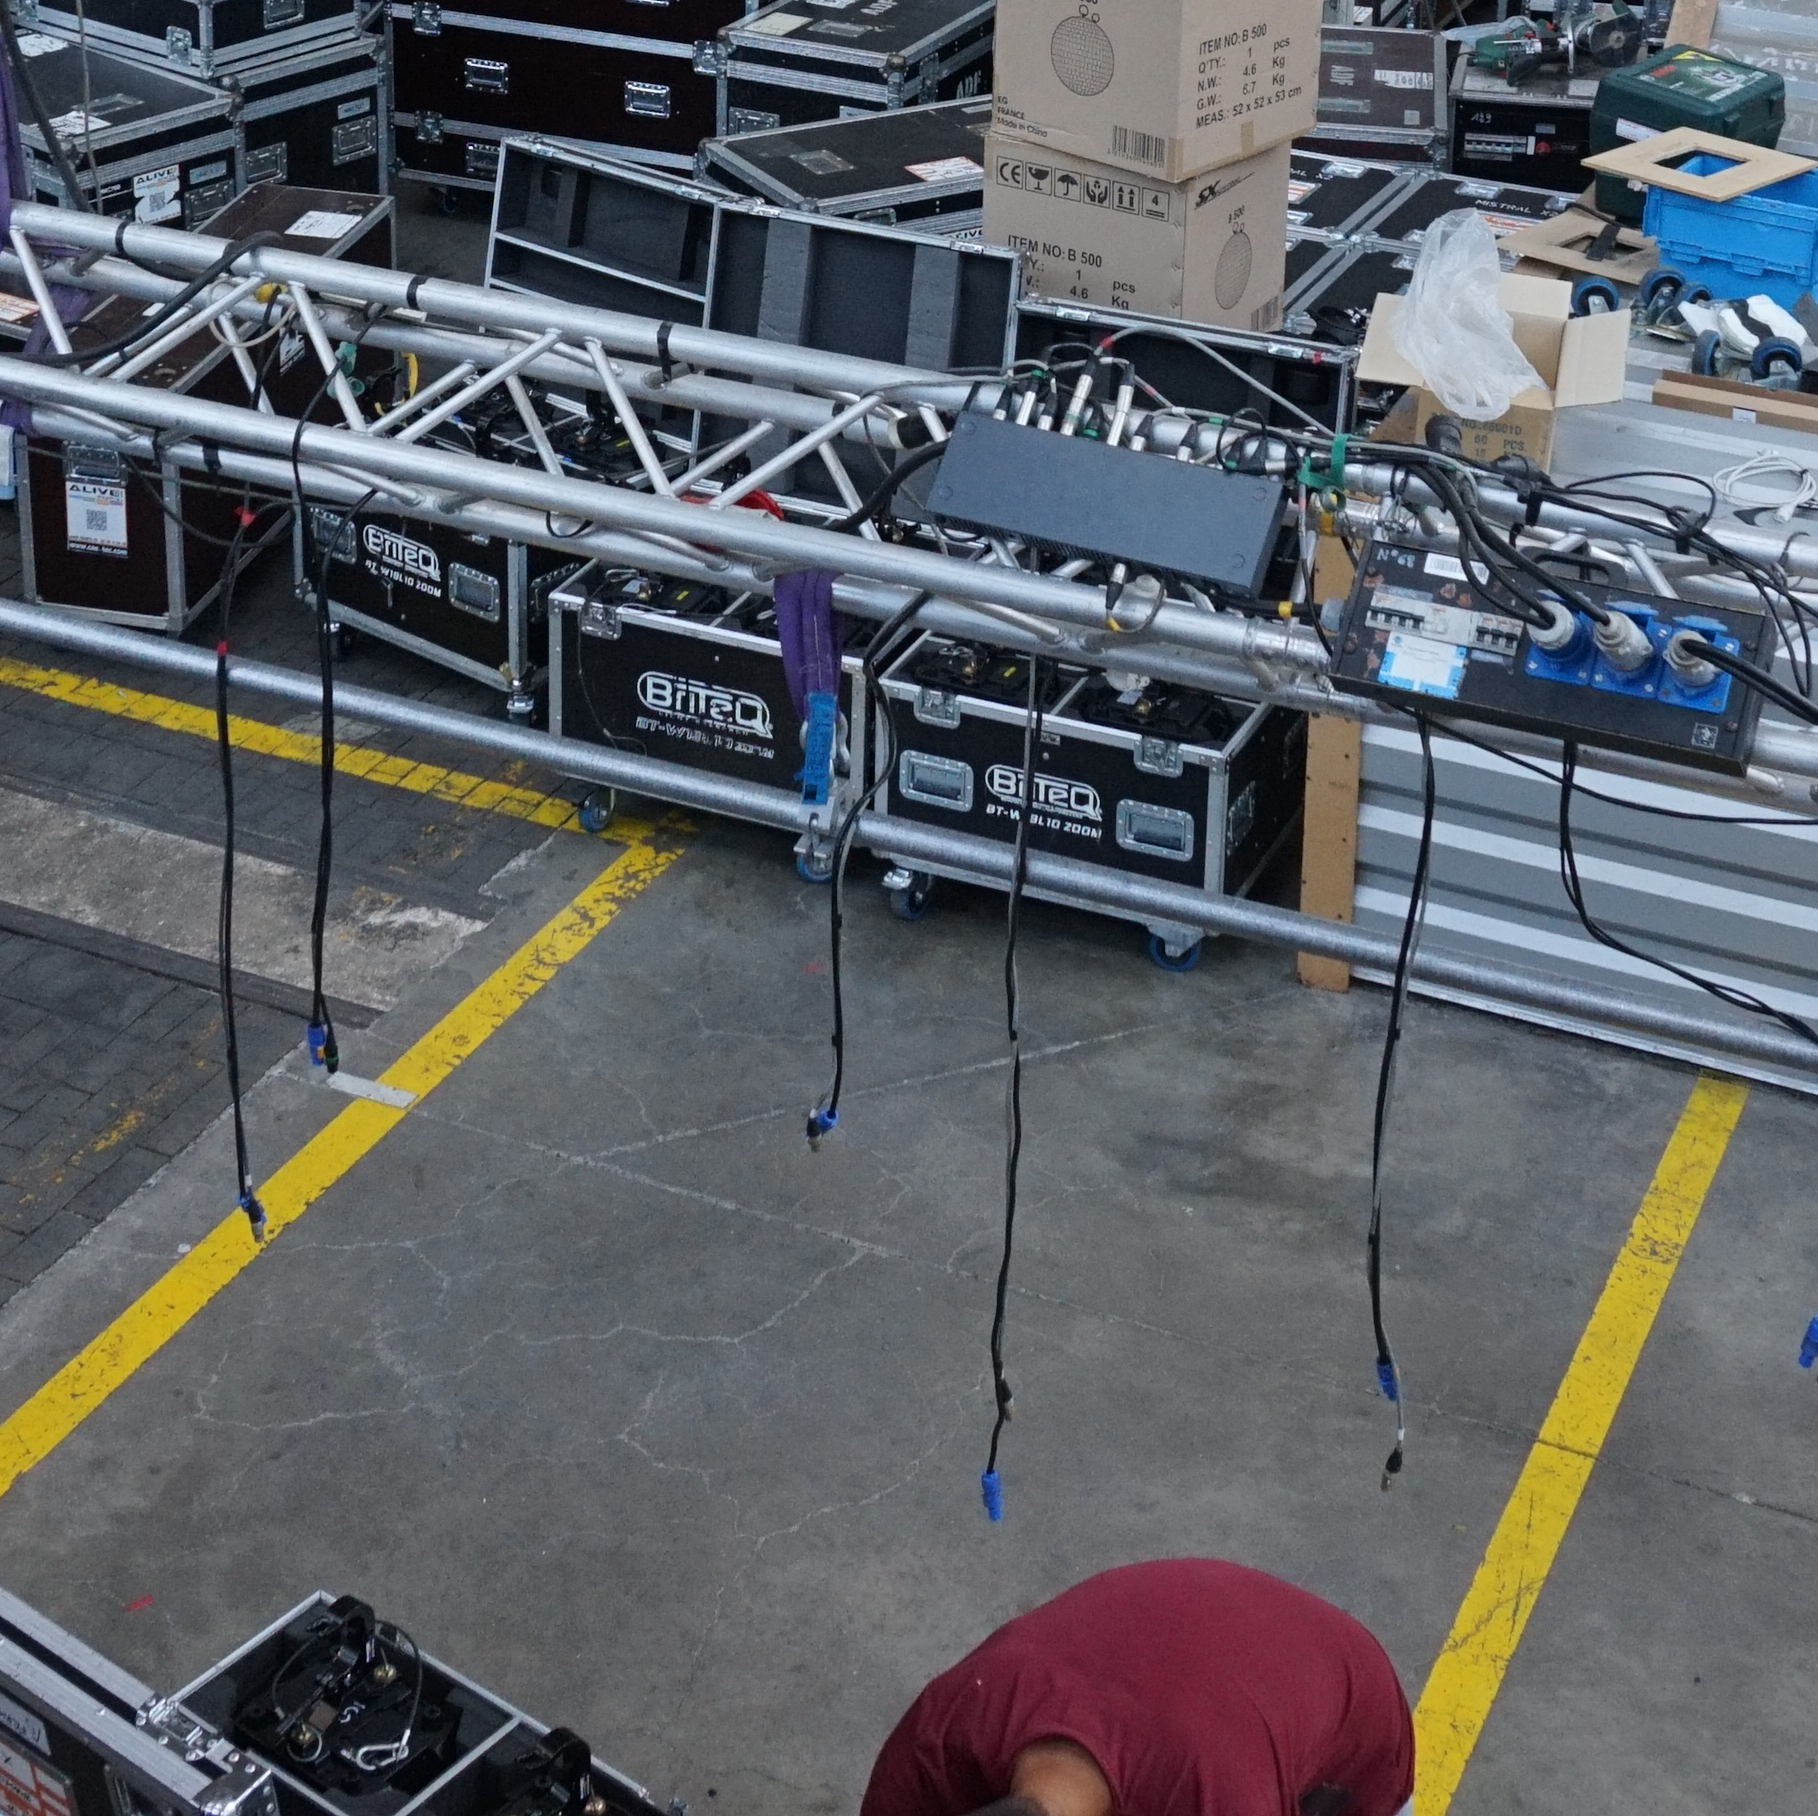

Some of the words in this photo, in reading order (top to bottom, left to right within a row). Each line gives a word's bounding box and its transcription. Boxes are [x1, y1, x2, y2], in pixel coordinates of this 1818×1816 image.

[1199, 35, 1222, 55] ITEM
[1251, 23, 1268, 41] 500
[1273, 37, 1291, 55] pcs
[1242, 63, 1258, 77] 4.6
[1272, 55, 1286, 70] Kg
[1242, 81, 1257, 96] 6.7
[1272, 73, 1286, 87] Kg
[1232, 102, 1244, 116] 52
[1253, 96, 1265, 111] 52
[1275, 90, 1287, 105] 53
[1288, 87, 1302, 99] cm
[1007, 234, 1039, 253] ITEM
[1067, 248, 1077, 263] B
[1080, 251, 1103, 269] 500
[1069, 285, 1090, 300] 4.6
[1112, 280, 1137, 295] pcs
